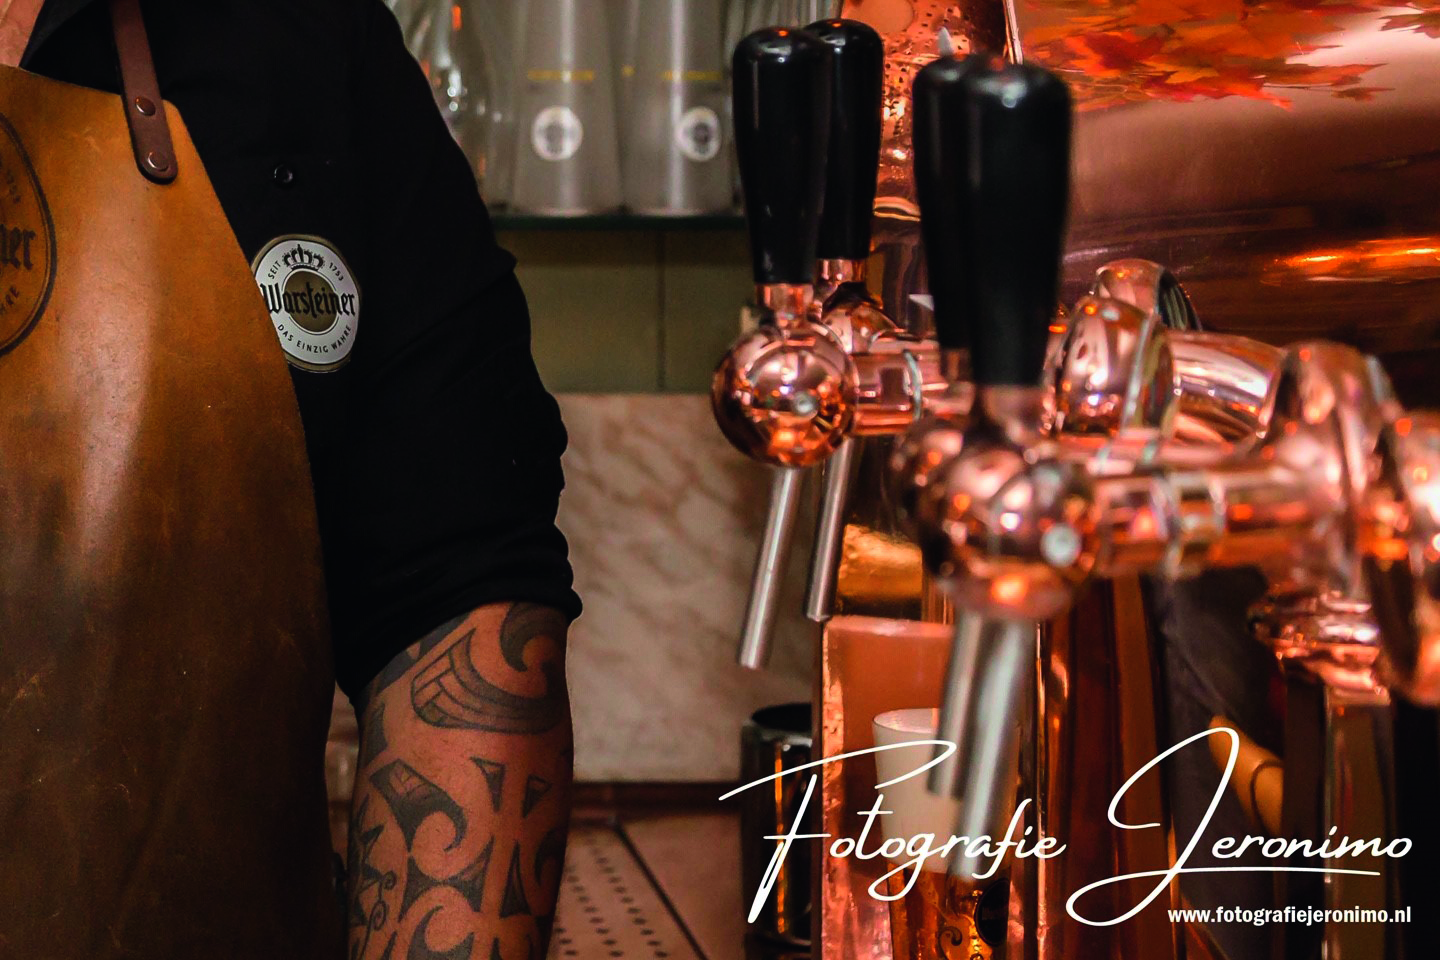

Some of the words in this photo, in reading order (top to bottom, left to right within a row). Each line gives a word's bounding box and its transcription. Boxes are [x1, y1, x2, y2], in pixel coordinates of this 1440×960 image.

[268, 260, 282, 280] SEIT
[328, 263, 344, 282] 1753
[260, 282, 355, 319] Warsteiner
[277, 323, 294, 342] DAS
[296, 341, 329, 354] EINZIG
[331, 325, 352, 351] WAHRE
